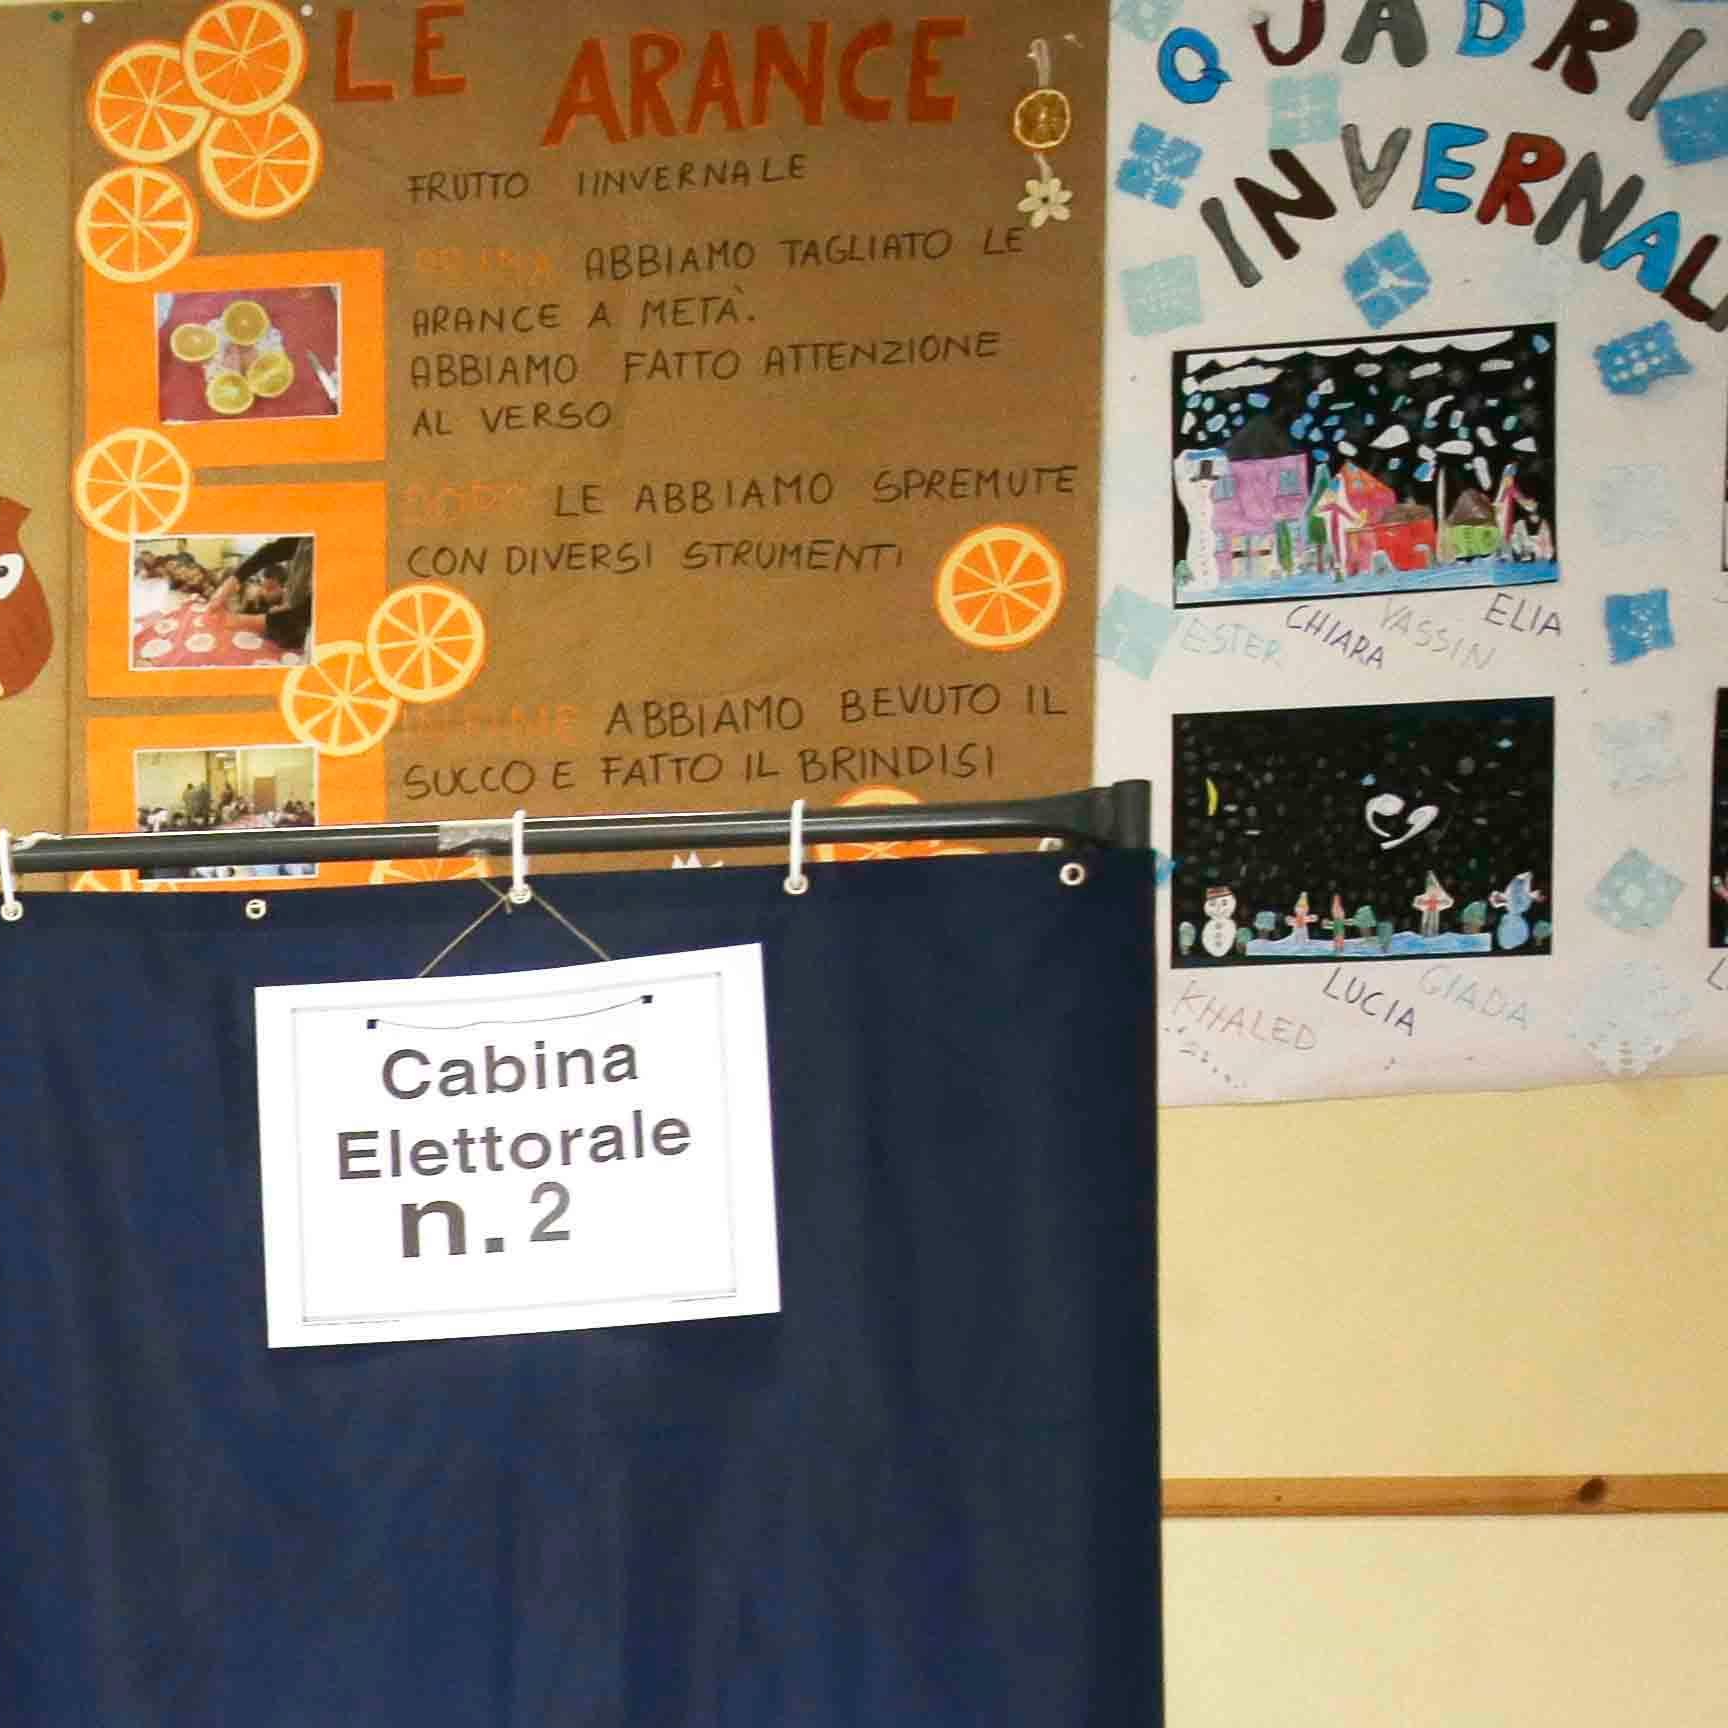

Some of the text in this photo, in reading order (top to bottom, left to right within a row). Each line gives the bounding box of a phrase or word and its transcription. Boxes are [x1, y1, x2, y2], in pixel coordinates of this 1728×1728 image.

[333, 3, 968, 151] LE ARANCE
[1157, 0, 1707, 121] QUADRI
[406, 169, 530, 203] FRUTTO
[585, 240, 755, 281] ABBIAMO
[780, 229, 952, 268] TAGLIATO
[983, 226, 1026, 256] LE
[1199, 122, 1728, 332] INVERNAL
[412, 303, 561, 338] ARANCE
[587, 301, 611, 330] A
[410, 330, 1001, 390] ABBIAMO FATTO ATTENZIONE
[411, 400, 612, 438] AL VERSO
[553, 484, 605, 518] LE
[635, 472, 834, 516] ABBIAMO
[872, 464, 1079, 503] SPREMUTE
[407, 540, 904, 578] CON DIVERSI STRUMENTI
[1284, 603, 1388, 671] CHIARA
[1482, 591, 1566, 638] ELIA
[604, 694, 804, 740] ABBIAMO
[840, 683, 1002, 725] BEVUTO
[1026, 684, 1068, 717] IL
[402, 742, 996, 801] SUCCO E FATTO IL BRINDISI
[1169, 978, 1320, 1053] KHALED
[1320, 965, 1418, 1039] LUCIA
[381, 1039, 639, 1101] Cabina
[336, 1109, 692, 1181] Elettorale
[399, 1181, 571, 1259] n. 2
